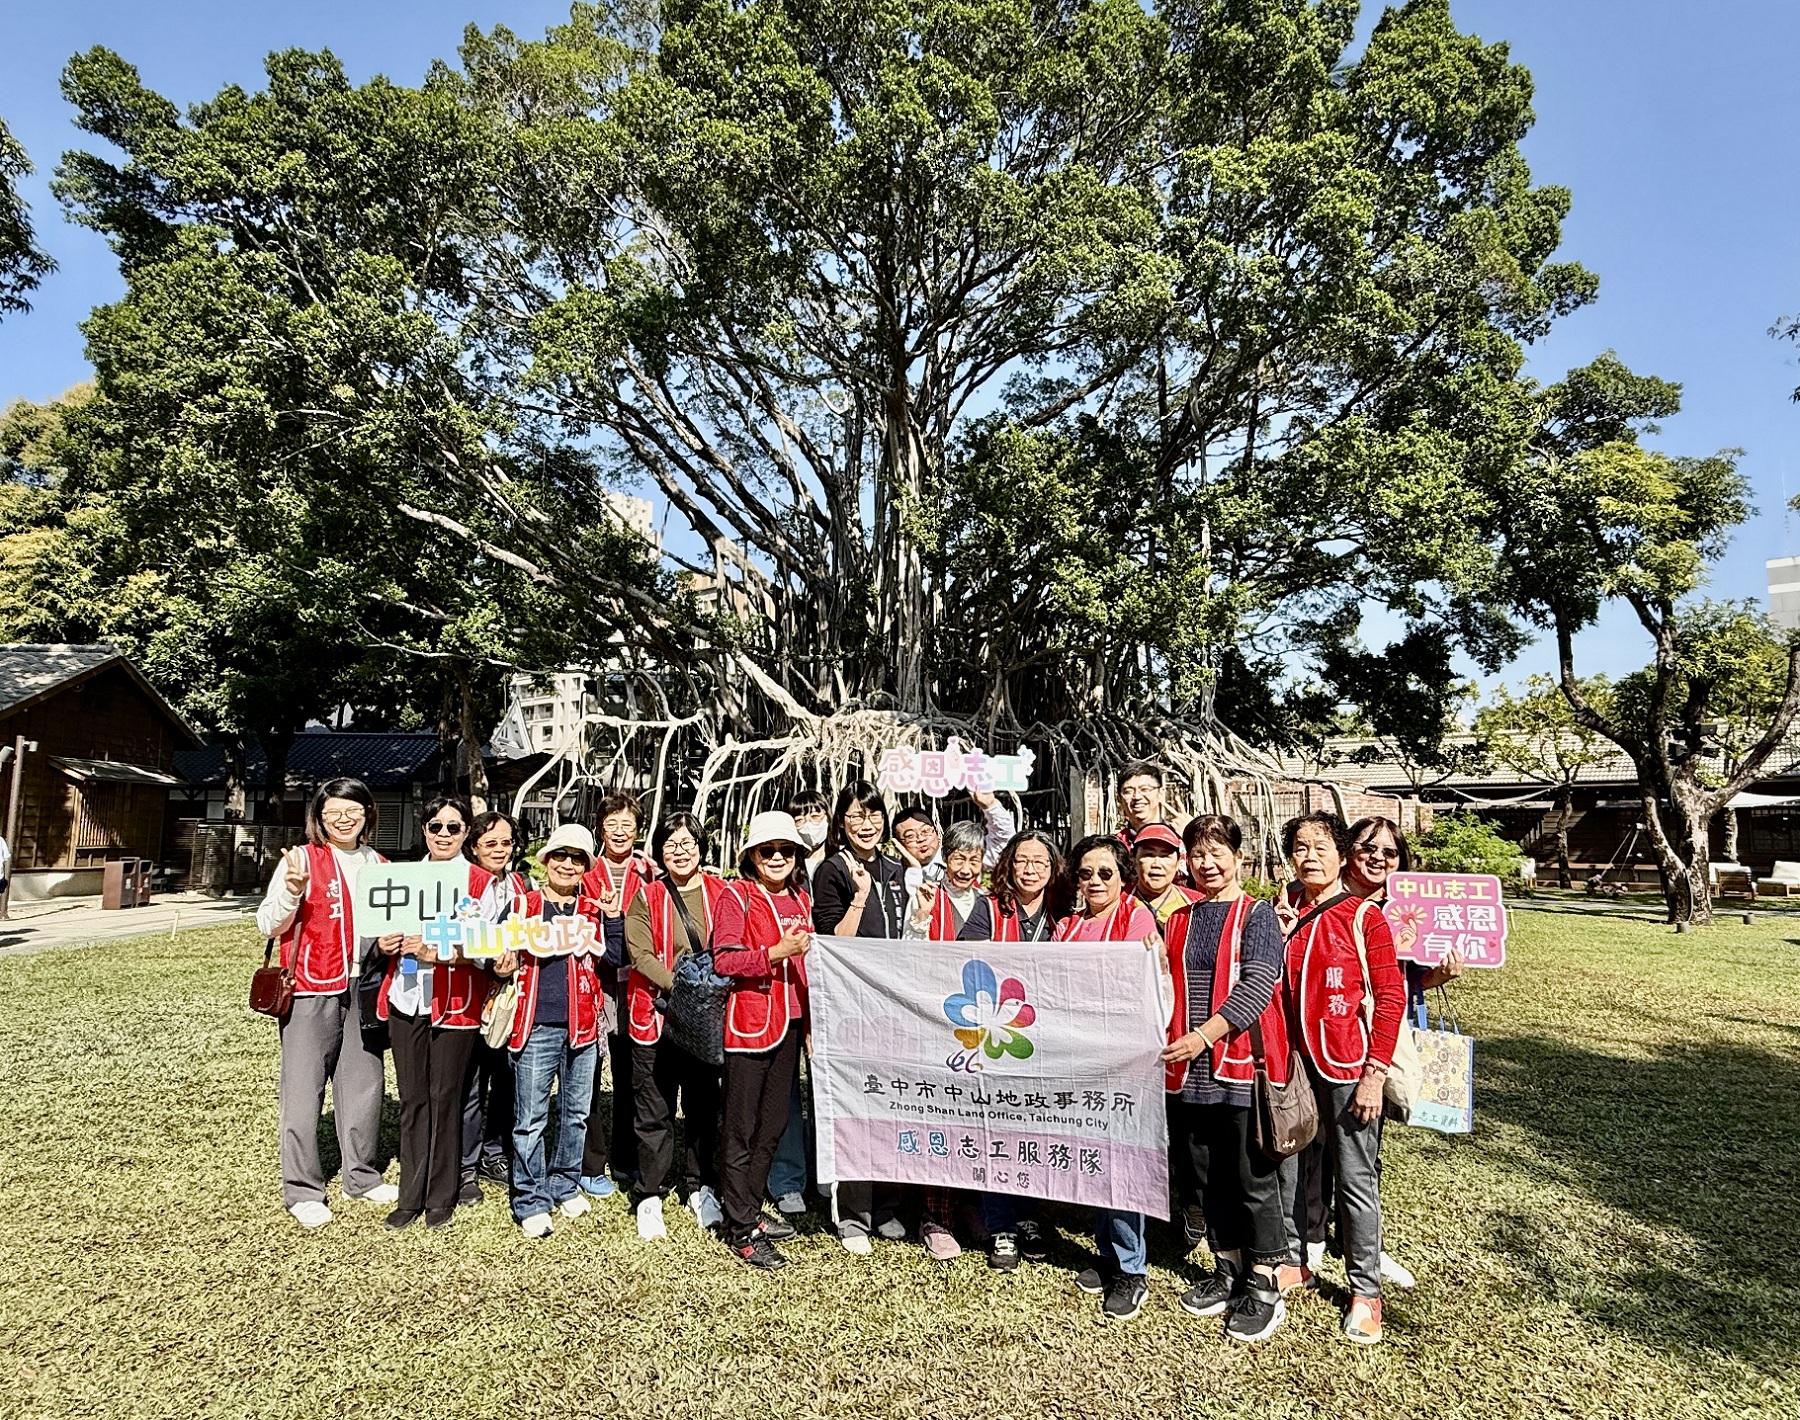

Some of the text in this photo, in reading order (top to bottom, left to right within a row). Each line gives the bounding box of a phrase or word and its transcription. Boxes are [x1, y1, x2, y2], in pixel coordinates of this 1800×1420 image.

[880, 750, 1024, 794] 感恩志工
[369, 878, 458, 921] 中山
[1395, 878, 1492, 900] 中山志工
[425, 915, 603, 956] 中山地政
[1433, 904, 1498, 931] 感恩
[1422, 932, 1487, 960] 有你
[1325, 967, 1350, 1016] 服務
[863, 1073, 1136, 1117] 臺中市中山地政事務所
[889, 1101, 1109, 1131] Zhong Shan Land Office, Taichung City
[897, 1129, 1104, 1175] 感恩志工服務隊
